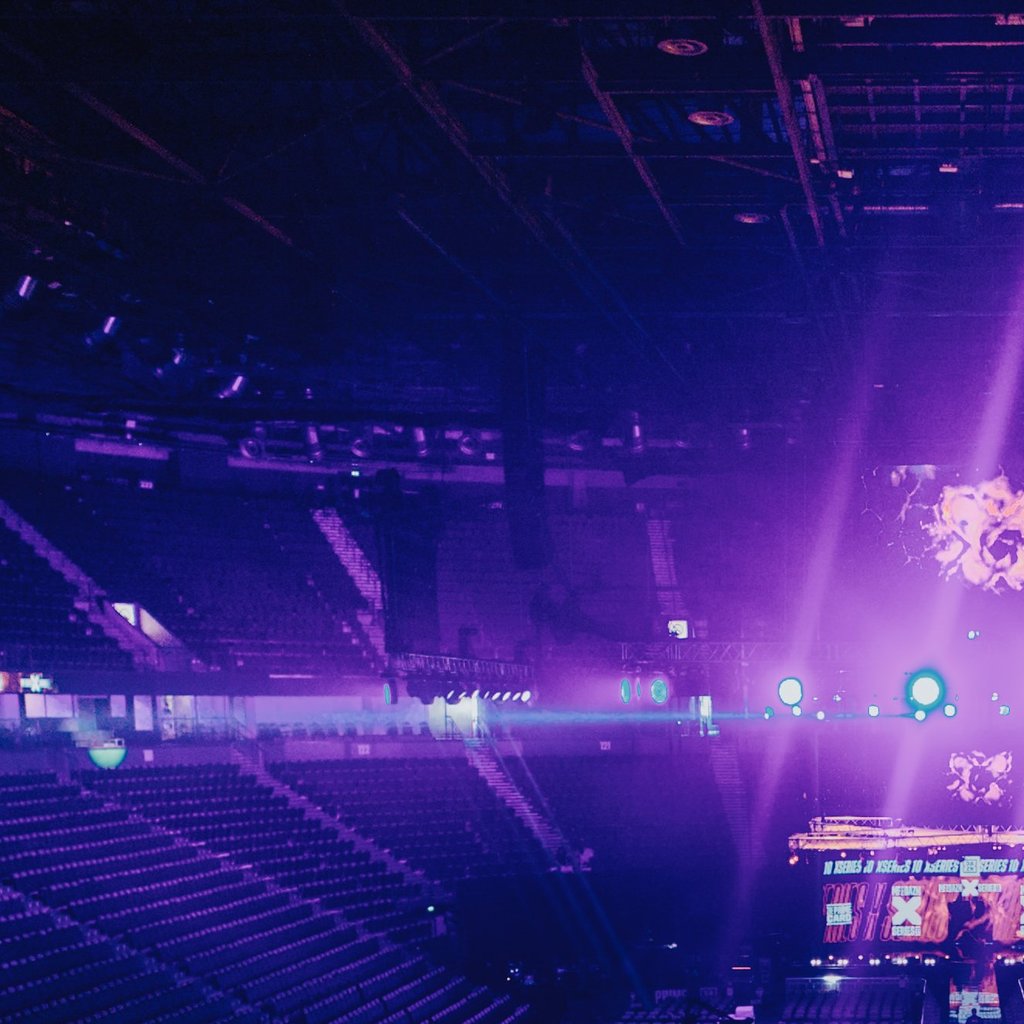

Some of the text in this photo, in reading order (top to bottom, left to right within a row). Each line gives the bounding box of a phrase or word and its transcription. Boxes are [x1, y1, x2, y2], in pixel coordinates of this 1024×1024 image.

[823, 861, 833, 875] 10
[834, 860, 862, 874] XSERIES
[912, 860, 923, 873] 10
[980, 858, 1009, 872] SERIES
